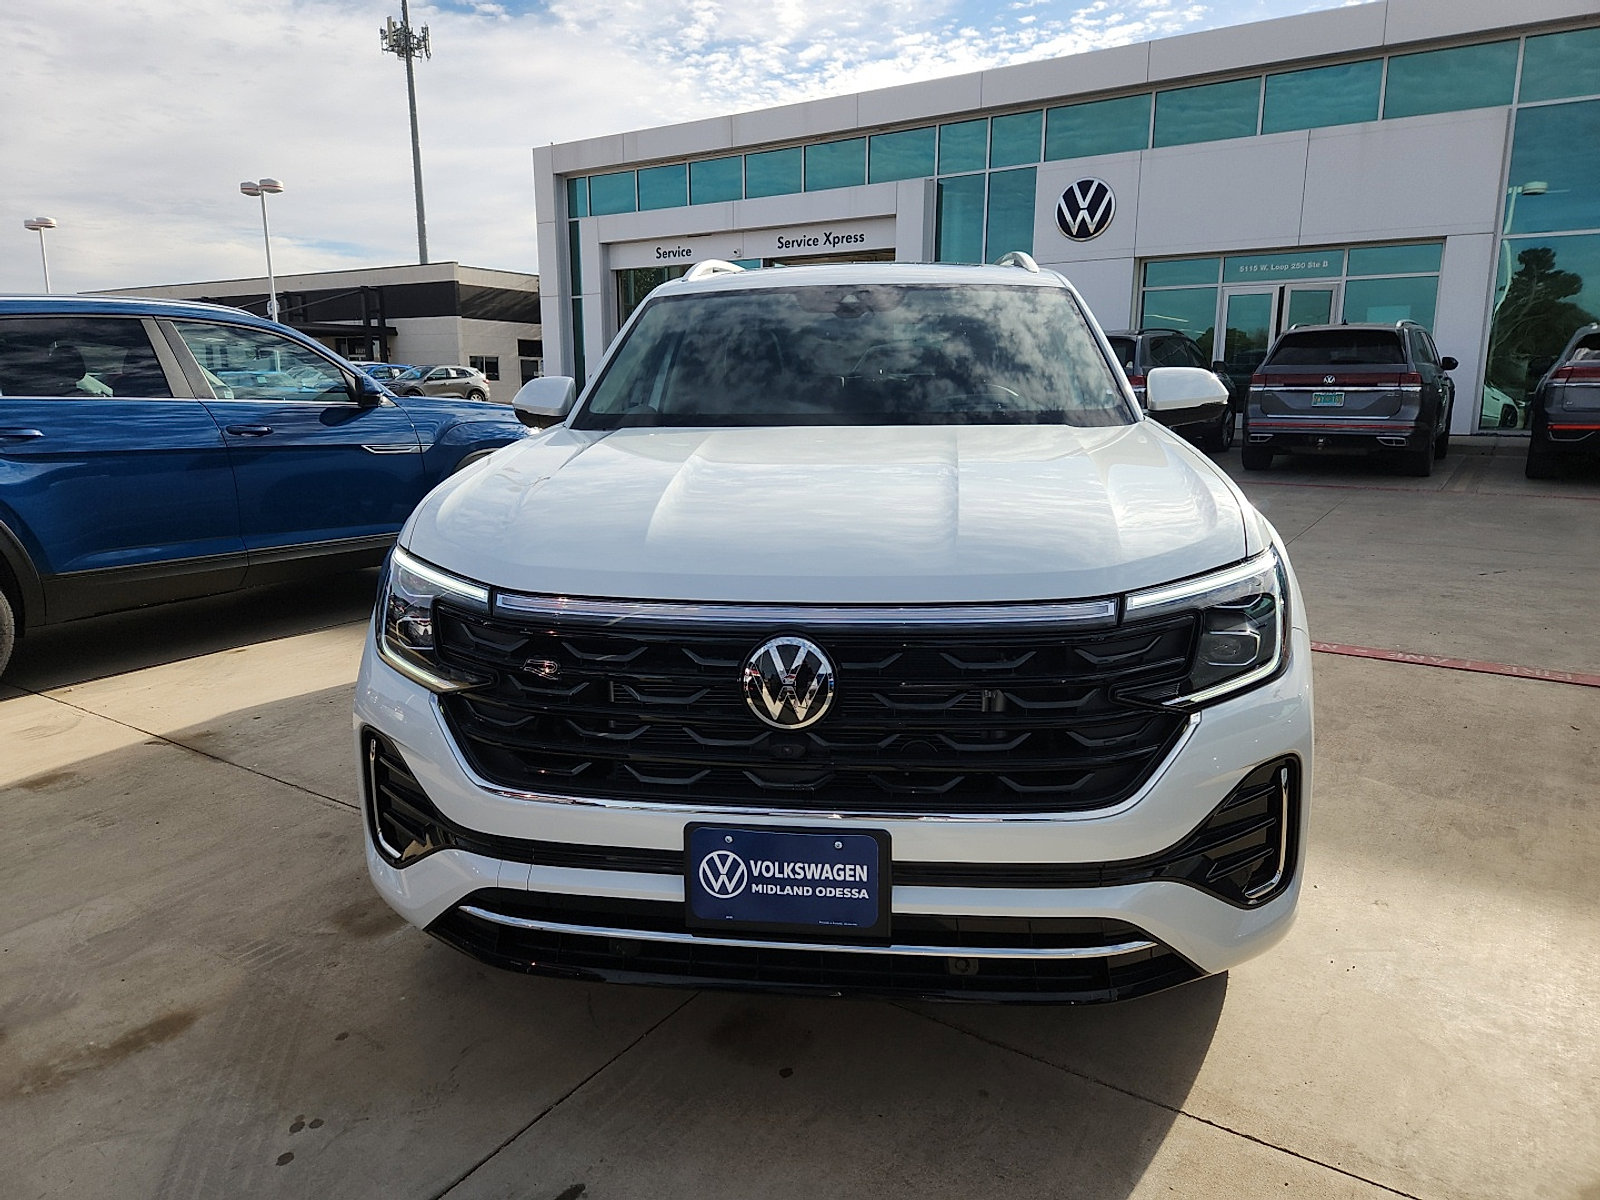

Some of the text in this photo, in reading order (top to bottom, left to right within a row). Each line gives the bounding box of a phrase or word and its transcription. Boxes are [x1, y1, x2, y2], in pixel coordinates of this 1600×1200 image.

[1055, 177, 1116, 242] VW
[777, 231, 865, 249] Service Xpress
[655, 246, 692, 259] Service
[744, 637, 835, 729] VW
[698, 850, 748, 899] VW
[750, 860, 868, 882] VOLKSWAGEN
[751, 882, 869, 900] MIDLAND ODESSA
